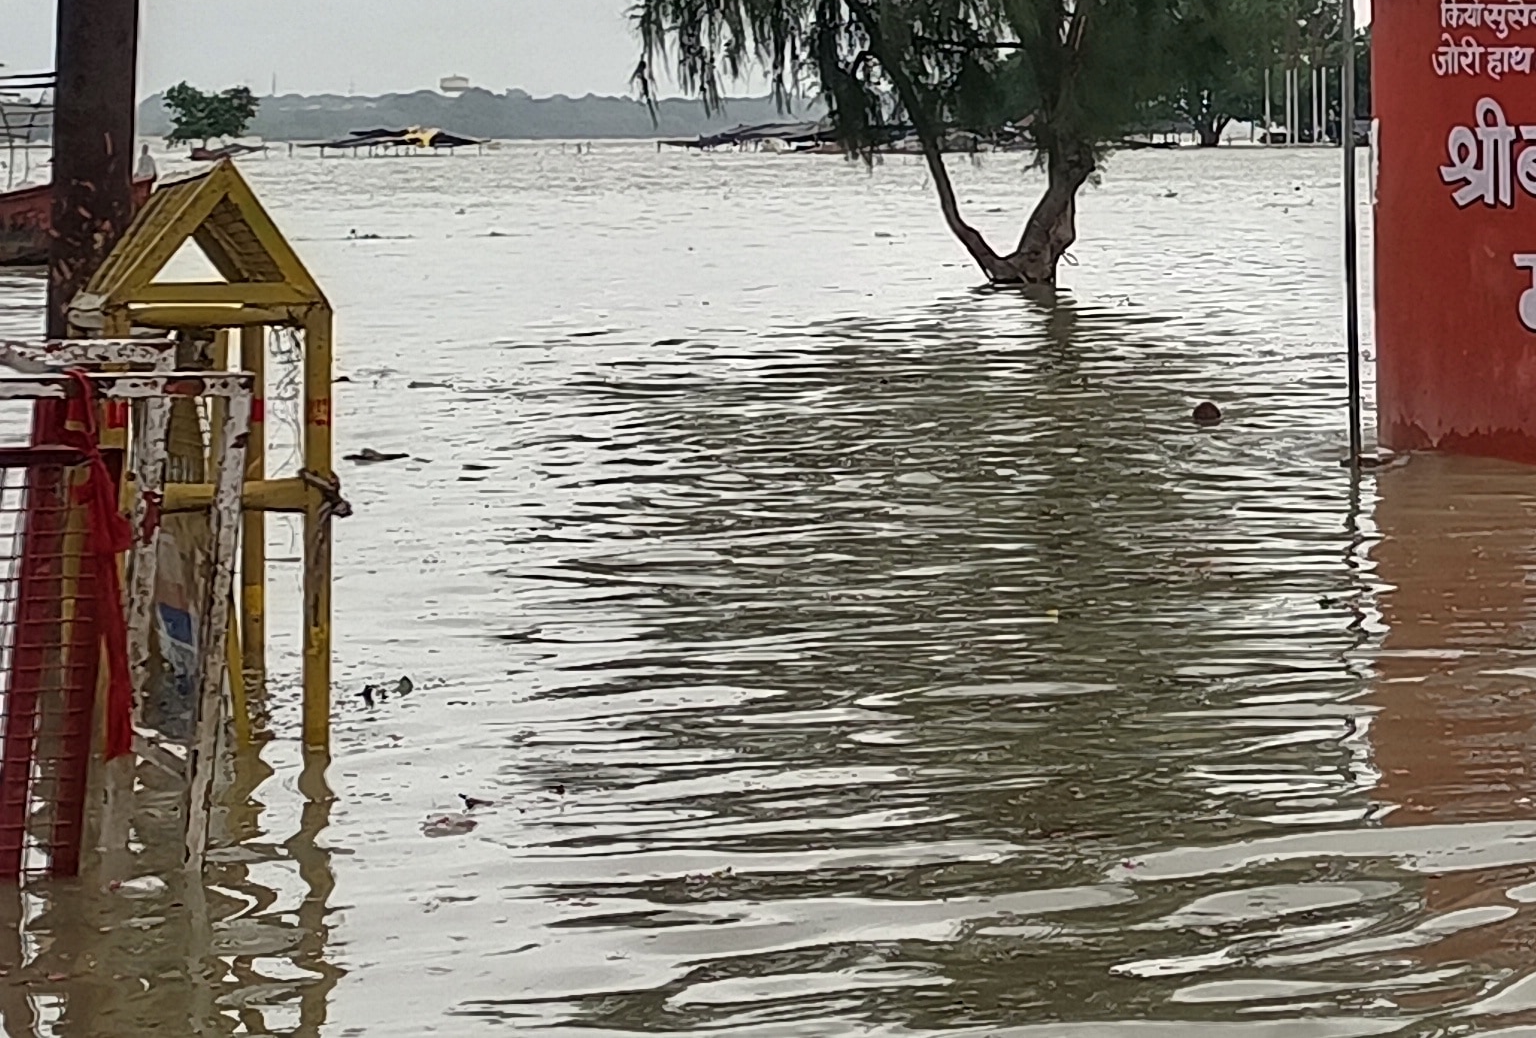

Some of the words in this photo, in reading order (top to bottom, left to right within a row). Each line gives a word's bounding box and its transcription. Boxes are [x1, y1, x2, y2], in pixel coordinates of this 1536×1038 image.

[1432, 33, 1485, 76] जोरी
[1487, 46, 1535, 80] हाथ
[1440, 96, 1515, 208] श्री
